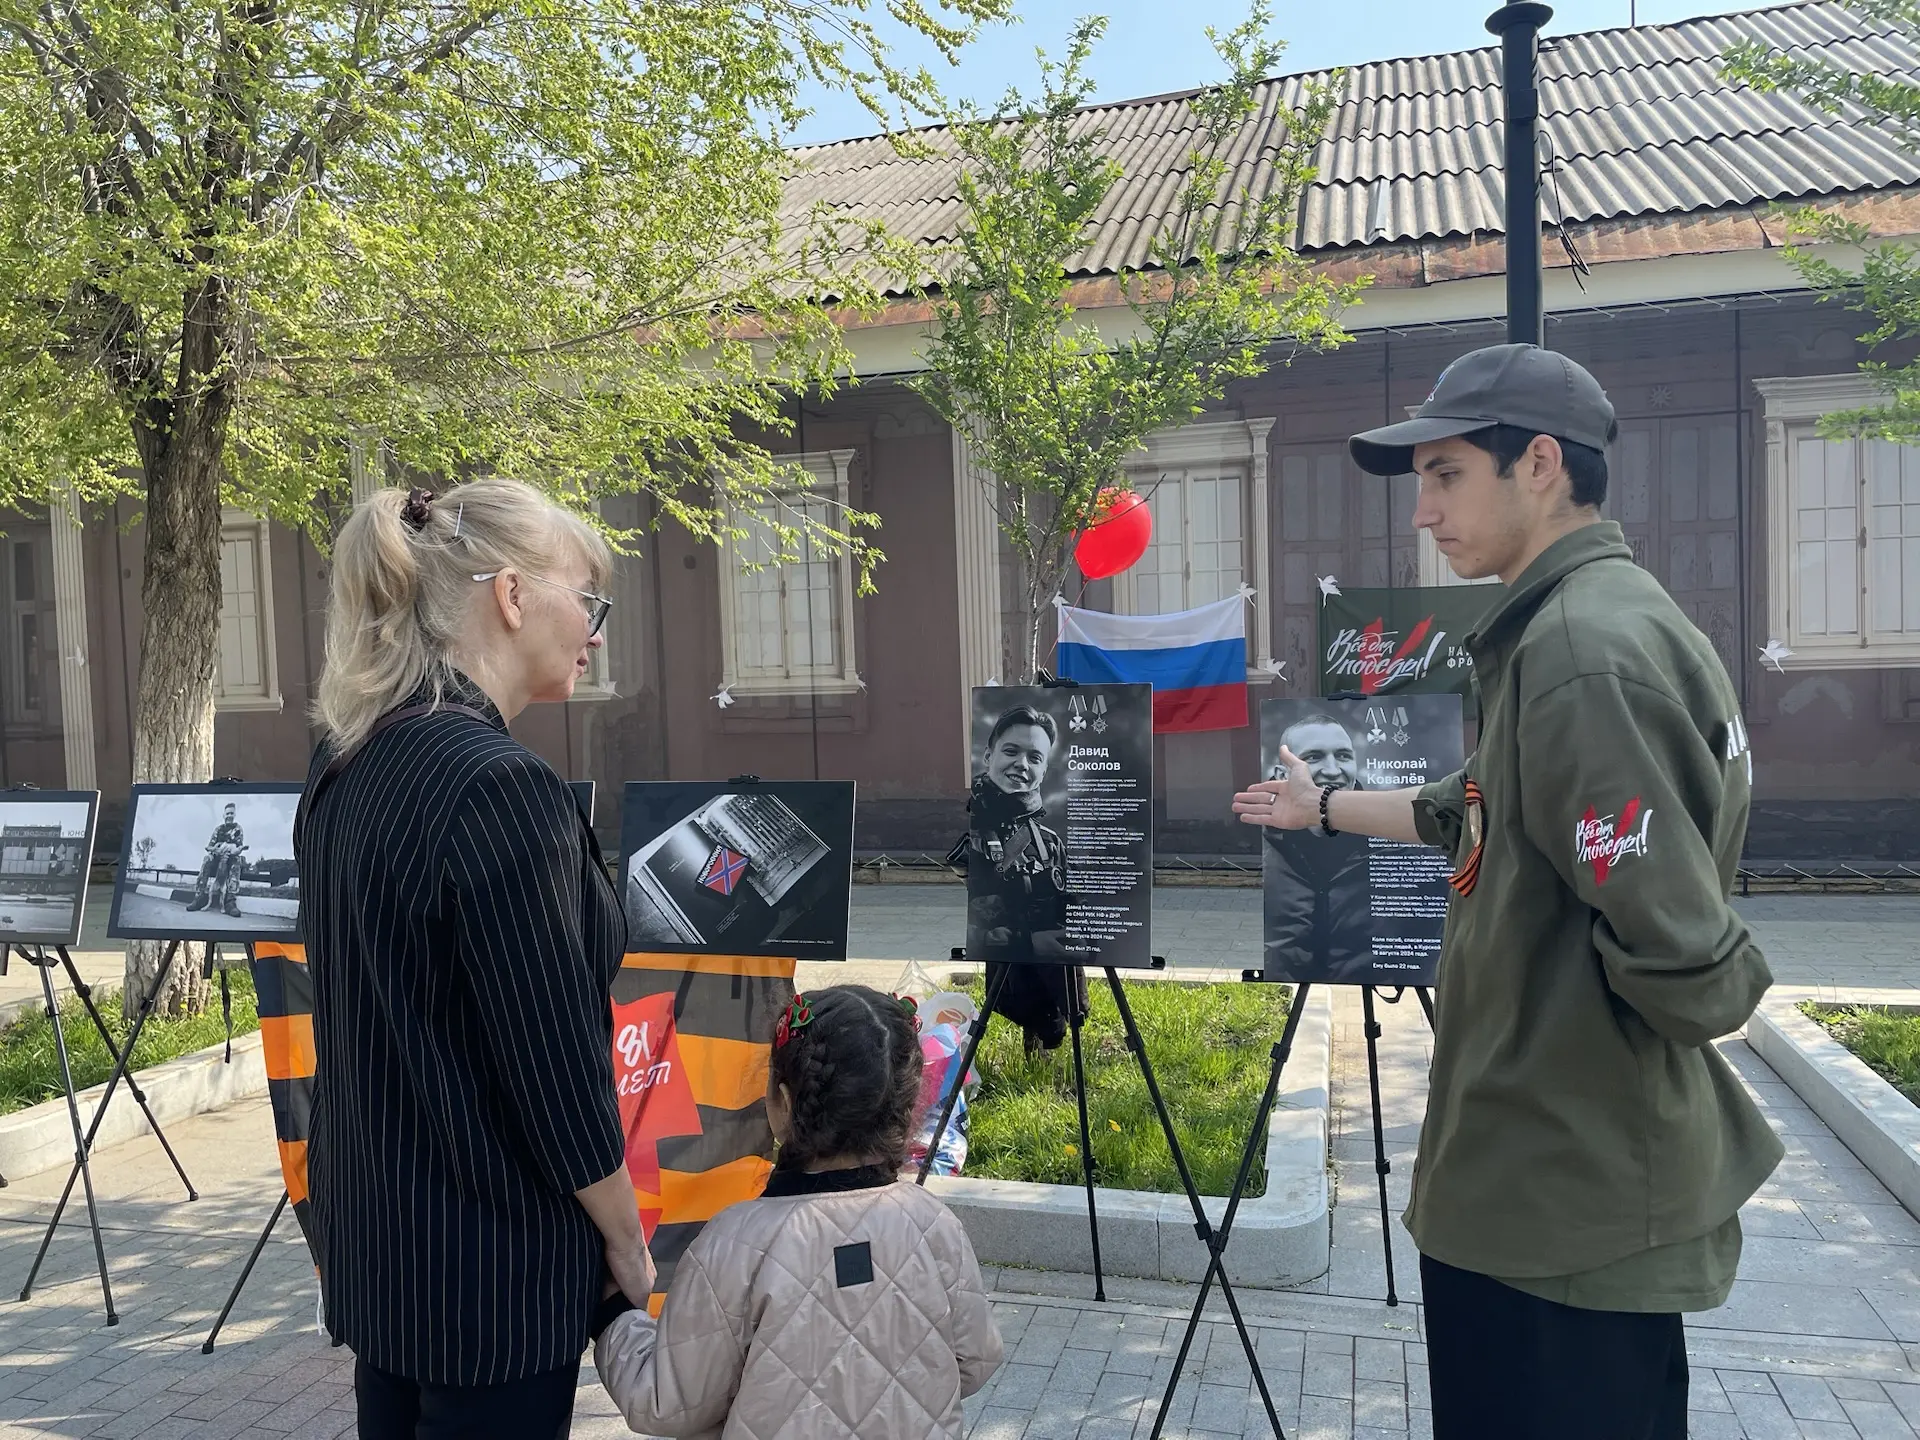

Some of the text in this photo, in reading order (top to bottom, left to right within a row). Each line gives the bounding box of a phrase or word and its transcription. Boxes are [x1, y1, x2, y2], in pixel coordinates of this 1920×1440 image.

[1448, 646, 1470, 656] НА
[1447, 657, 1473, 669] ФРО
[1069, 745, 1109, 758] Давид
[1068, 760, 1120, 770] Соколов
[1366, 758, 1427, 769] Николай
[1367, 773, 1425, 784] Ковалёв
